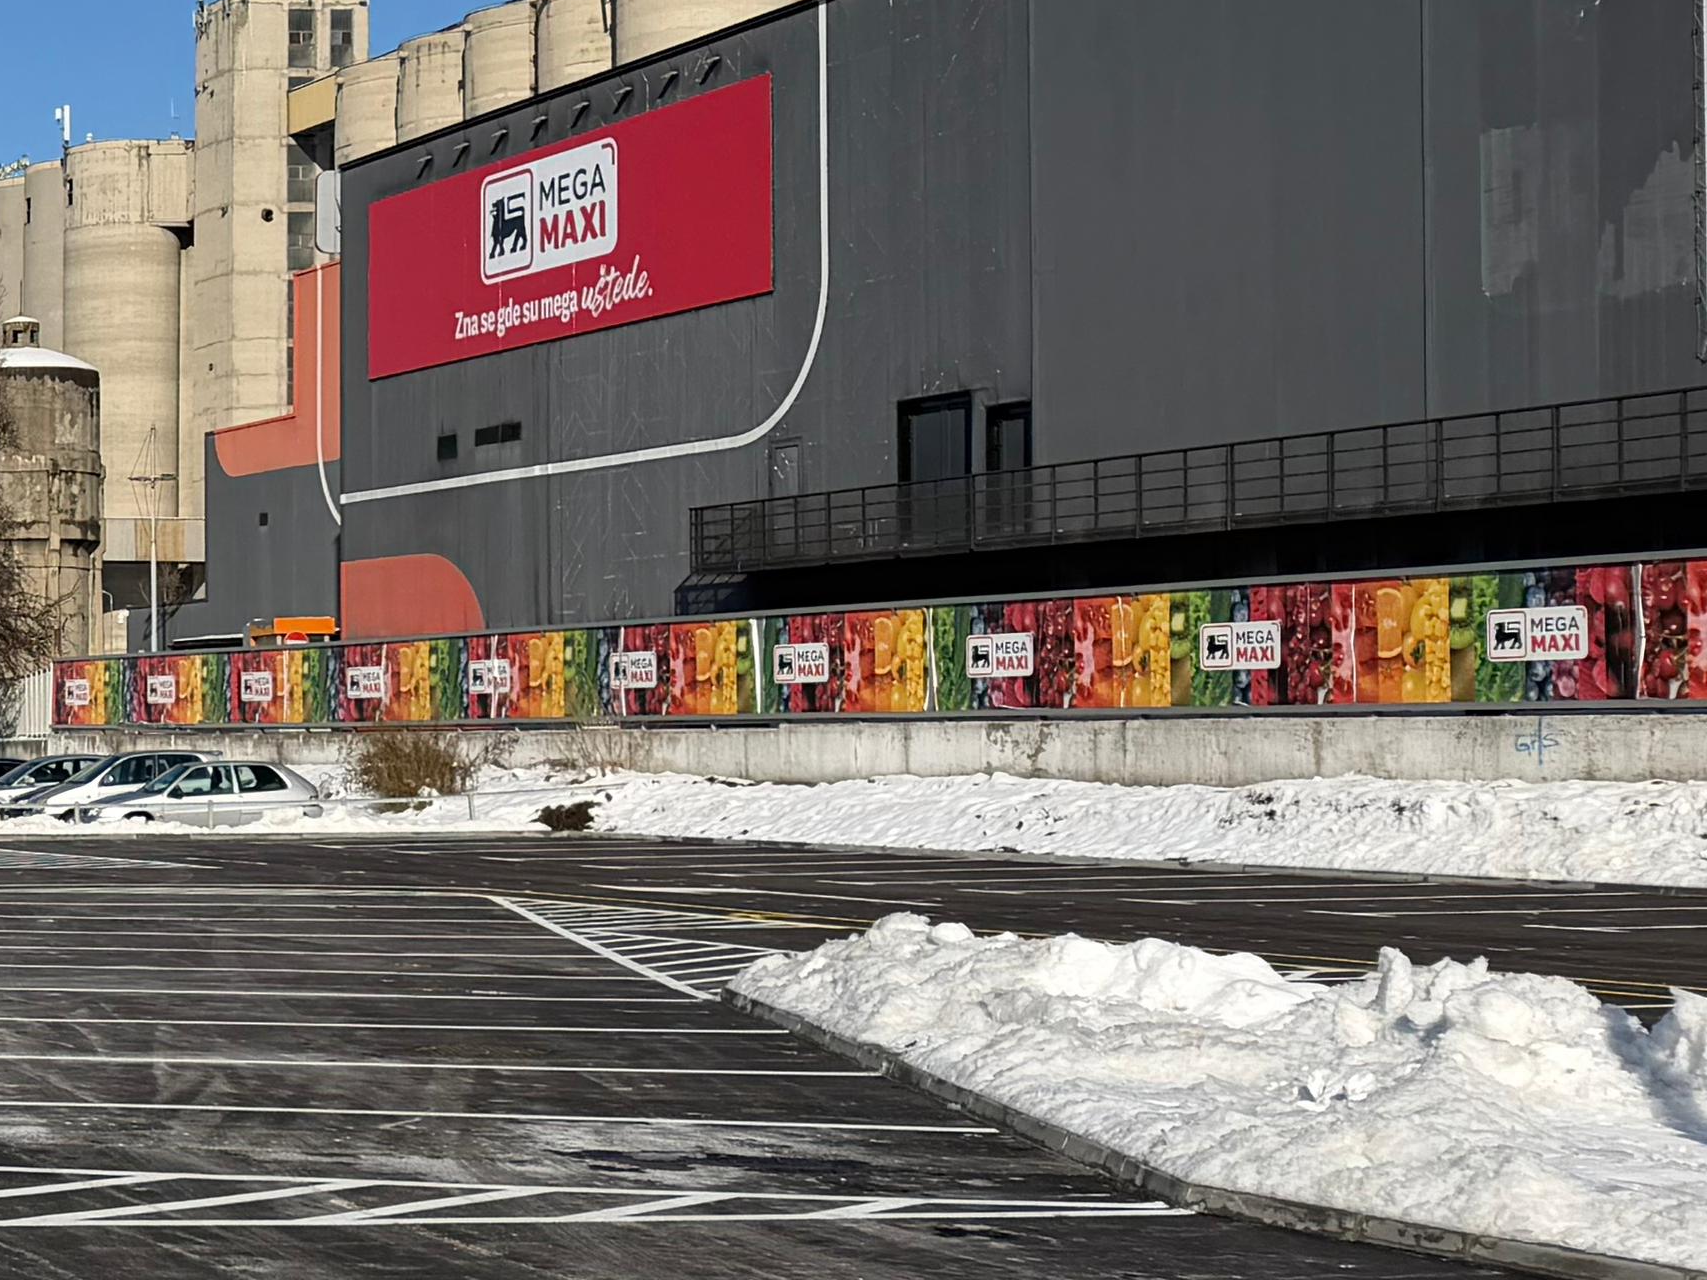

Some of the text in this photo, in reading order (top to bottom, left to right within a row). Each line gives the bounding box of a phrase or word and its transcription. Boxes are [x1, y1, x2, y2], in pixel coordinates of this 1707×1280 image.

[539, 163, 606, 211] MEGA
[539, 199, 606, 253] MAXI
[454, 254, 654, 340] Zna se gde su mega uštede.
[1530, 616, 1580, 632] MEGA
[1236, 630, 1275, 644] MEGA
[1530, 634, 1580, 653] MAXI
[995, 641, 1028, 655] MEGA
[1236, 646, 1275, 662] MAXI
[630, 658, 653, 669] MEGA
[798, 651, 825, 662] MEGA
[995, 656, 1029, 671] MAXI
[362, 672, 380, 682] MEGA
[630, 670, 654, 683] MAXI
[798, 663, 825, 677] MAXI
[362, 682, 381, 693] MAXI
